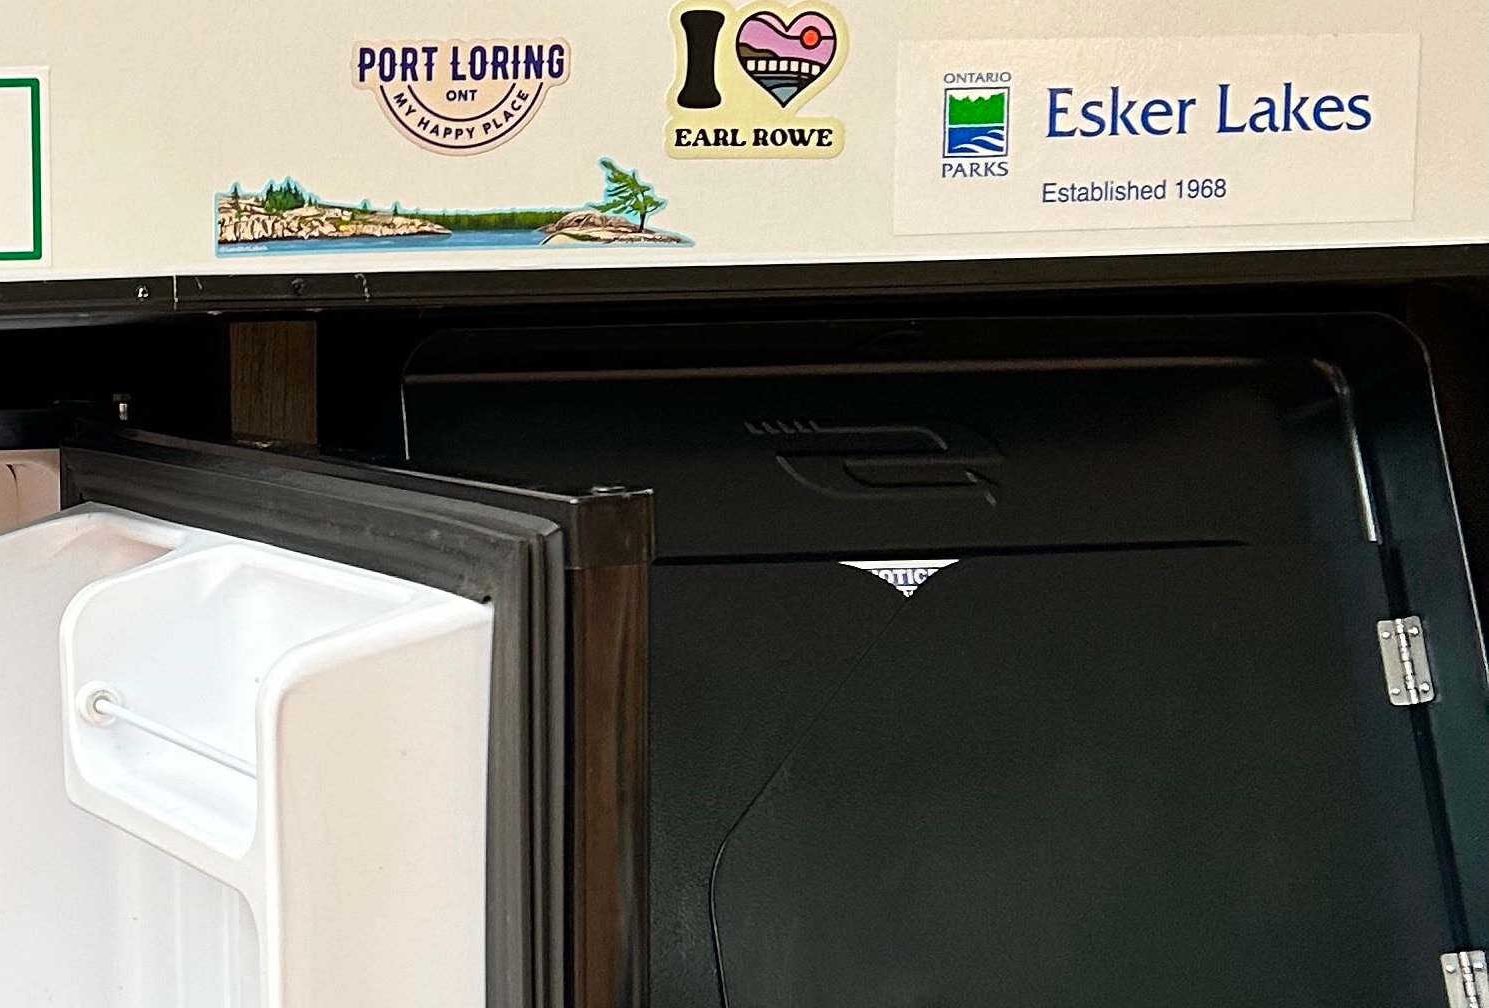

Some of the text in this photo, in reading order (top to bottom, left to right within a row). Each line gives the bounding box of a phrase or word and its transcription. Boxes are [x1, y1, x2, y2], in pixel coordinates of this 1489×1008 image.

[358, 44, 565, 82] PORT LORING
[677, 9, 725, 109] I
[943, 71, 1012, 84] ONTARIO
[446, 89, 478, 102] ONT
[393, 89, 530, 140] MY HAPPY PLACE
[1045, 82, 1373, 138] Esker Lakes
[674, 128, 834, 147] EARL ROWE
[941, 161, 1010, 179] PARKS
[1041, 178, 1227, 204] Established 1968
